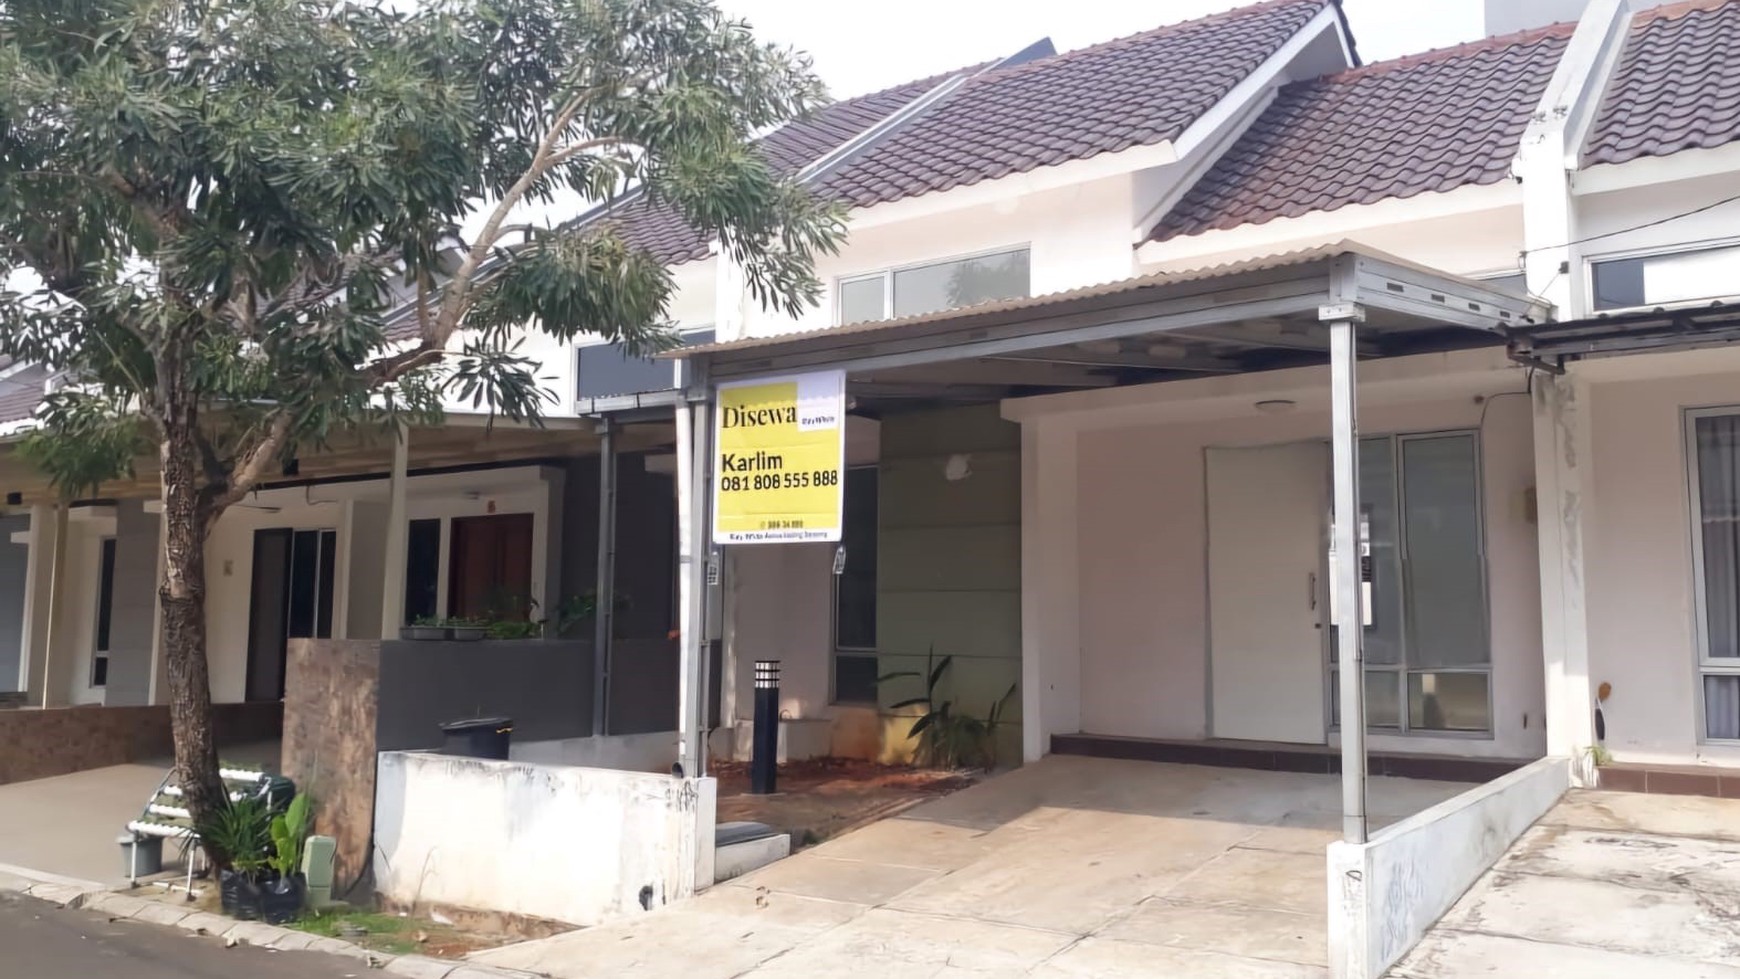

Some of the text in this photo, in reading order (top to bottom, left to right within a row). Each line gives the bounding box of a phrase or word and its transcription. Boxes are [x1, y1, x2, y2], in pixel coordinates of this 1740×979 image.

[721, 405, 798, 429] Disewa
[721, 451, 783, 472] Karlim
[721, 470, 838, 491] 081 808 555 888
